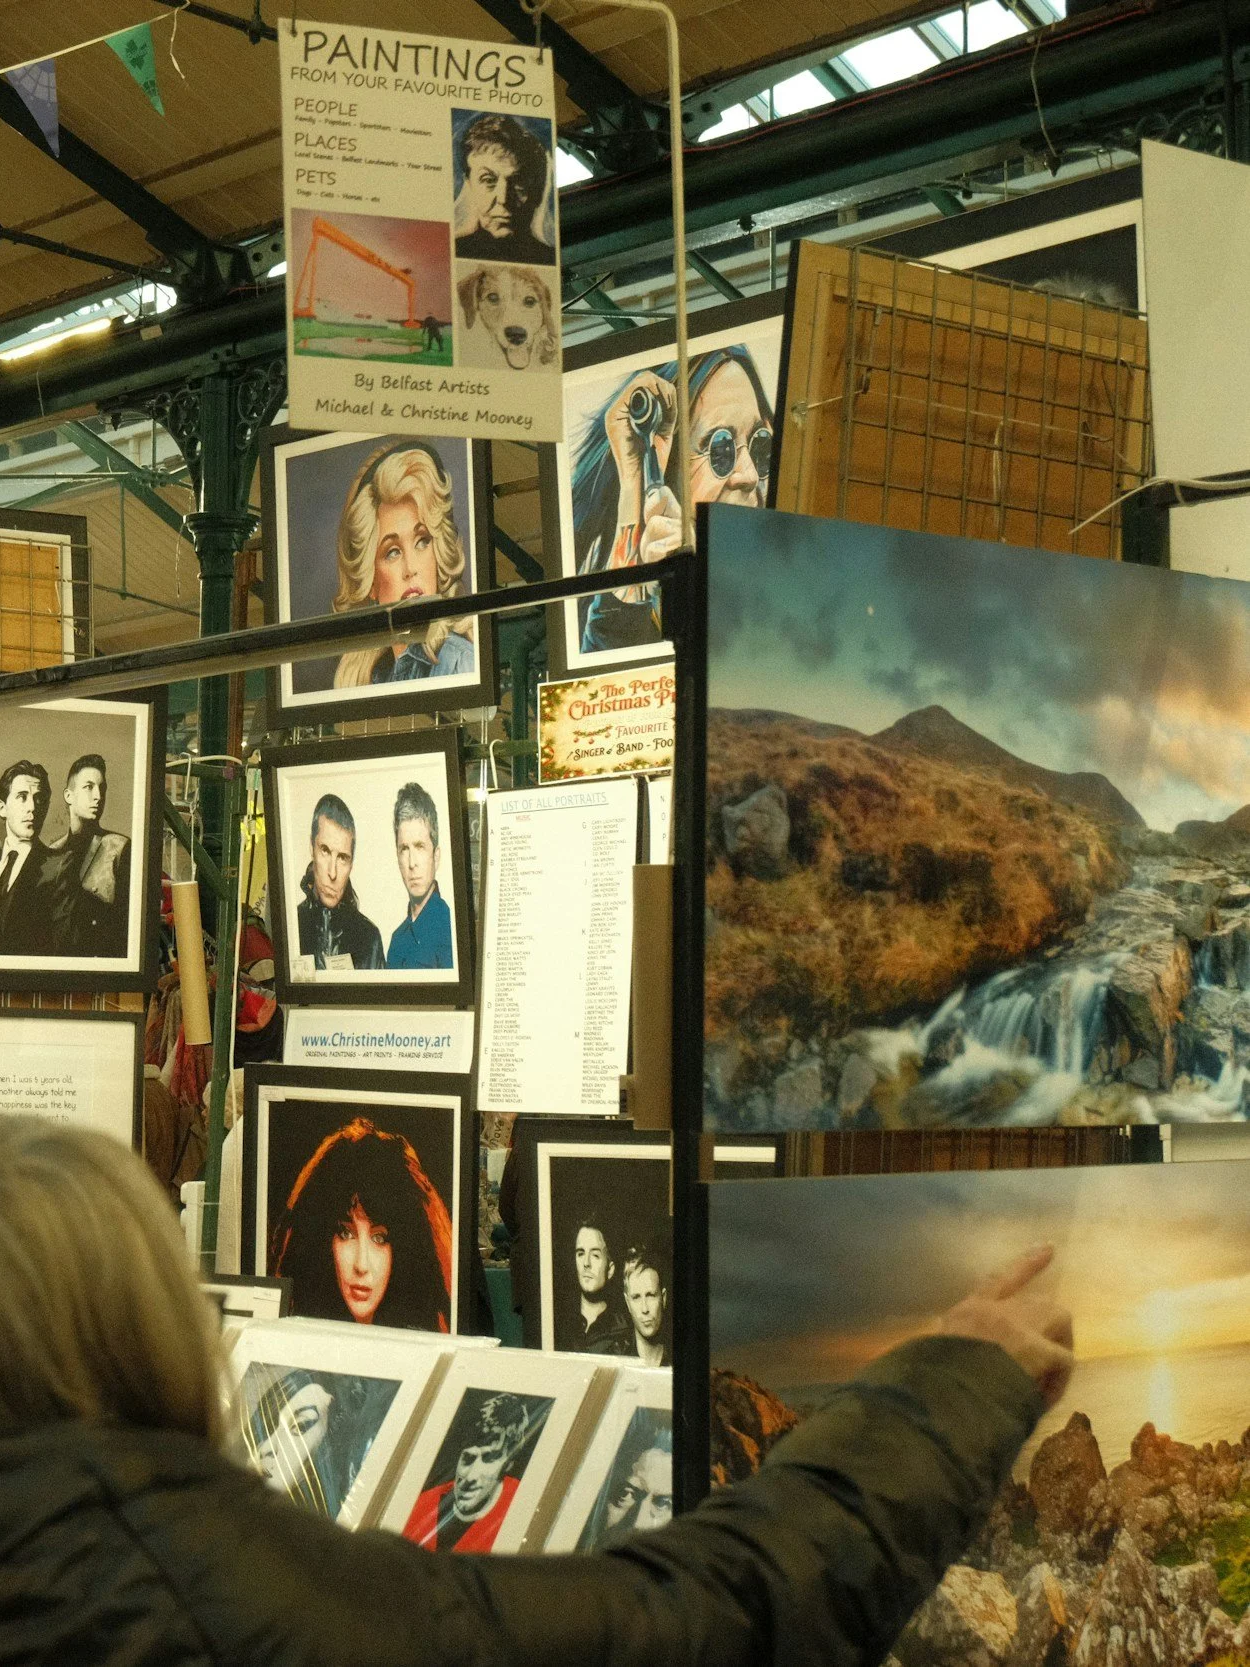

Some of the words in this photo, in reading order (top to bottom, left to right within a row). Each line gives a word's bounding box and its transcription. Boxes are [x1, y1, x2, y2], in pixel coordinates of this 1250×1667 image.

[304, 30, 526, 88] PAINTINGS
[290, 66, 337, 84] FROM
[343, 72, 388, 90] YOUR
[394, 78, 482, 101] FAVOURITE
[489, 89, 543, 108] PHOTO
[294, 97, 358, 117] PEOPLE
[294, 132, 358, 152] PLACES
[295, 168, 337, 185] PETS
[354, 373, 375, 392] By
[381, 374, 433, 392] Belfast
[438, 379, 491, 396] Artists
[315, 398, 374, 416] Michael
[381, 404, 394, 417] &
[401, 403, 469, 422] Christine
[475, 410, 533, 431] Mooney
[601, 683, 626, 700] The
[568, 694, 651, 721] Christmas
[615, 722, 669, 740] FAVOURITE
[573, 747, 605, 762] SINGER
[616, 741, 644, 756] BAND
[501, 800, 519, 813] LIST
[521, 798, 534, 810] OF
[536, 796, 553, 809] ALL
[554, 791, 607, 808] PORTRAITS
[489, 828, 495, 836] A
[581, 928, 586, 936] K
[301, 1031, 452, 1051] www.ChristineMooney.art
[305, 1051, 328, 1059] ORIGINAL
[328, 1051, 357, 1059] PAINTINGS
[362, 1051, 373, 1059] ART
[374, 1051, 393, 1059] PRINTS
[398, 1051, 421, 1059] FRAMING
[422, 1051, 443, 1060] SERVICE
[484, 1046, 489, 1055] E
[19, 1076, 33, 1084] was
[40, 1076, 60, 1086] years
[481, 1081, 486, 1089] F
[25, 1087, 49, 1098] always
[51, 1087, 64, 1097] told
[65, 1089, 77, 1097] me
[34, 1101, 48, 1109] was
[50, 1099, 62, 1109] the
